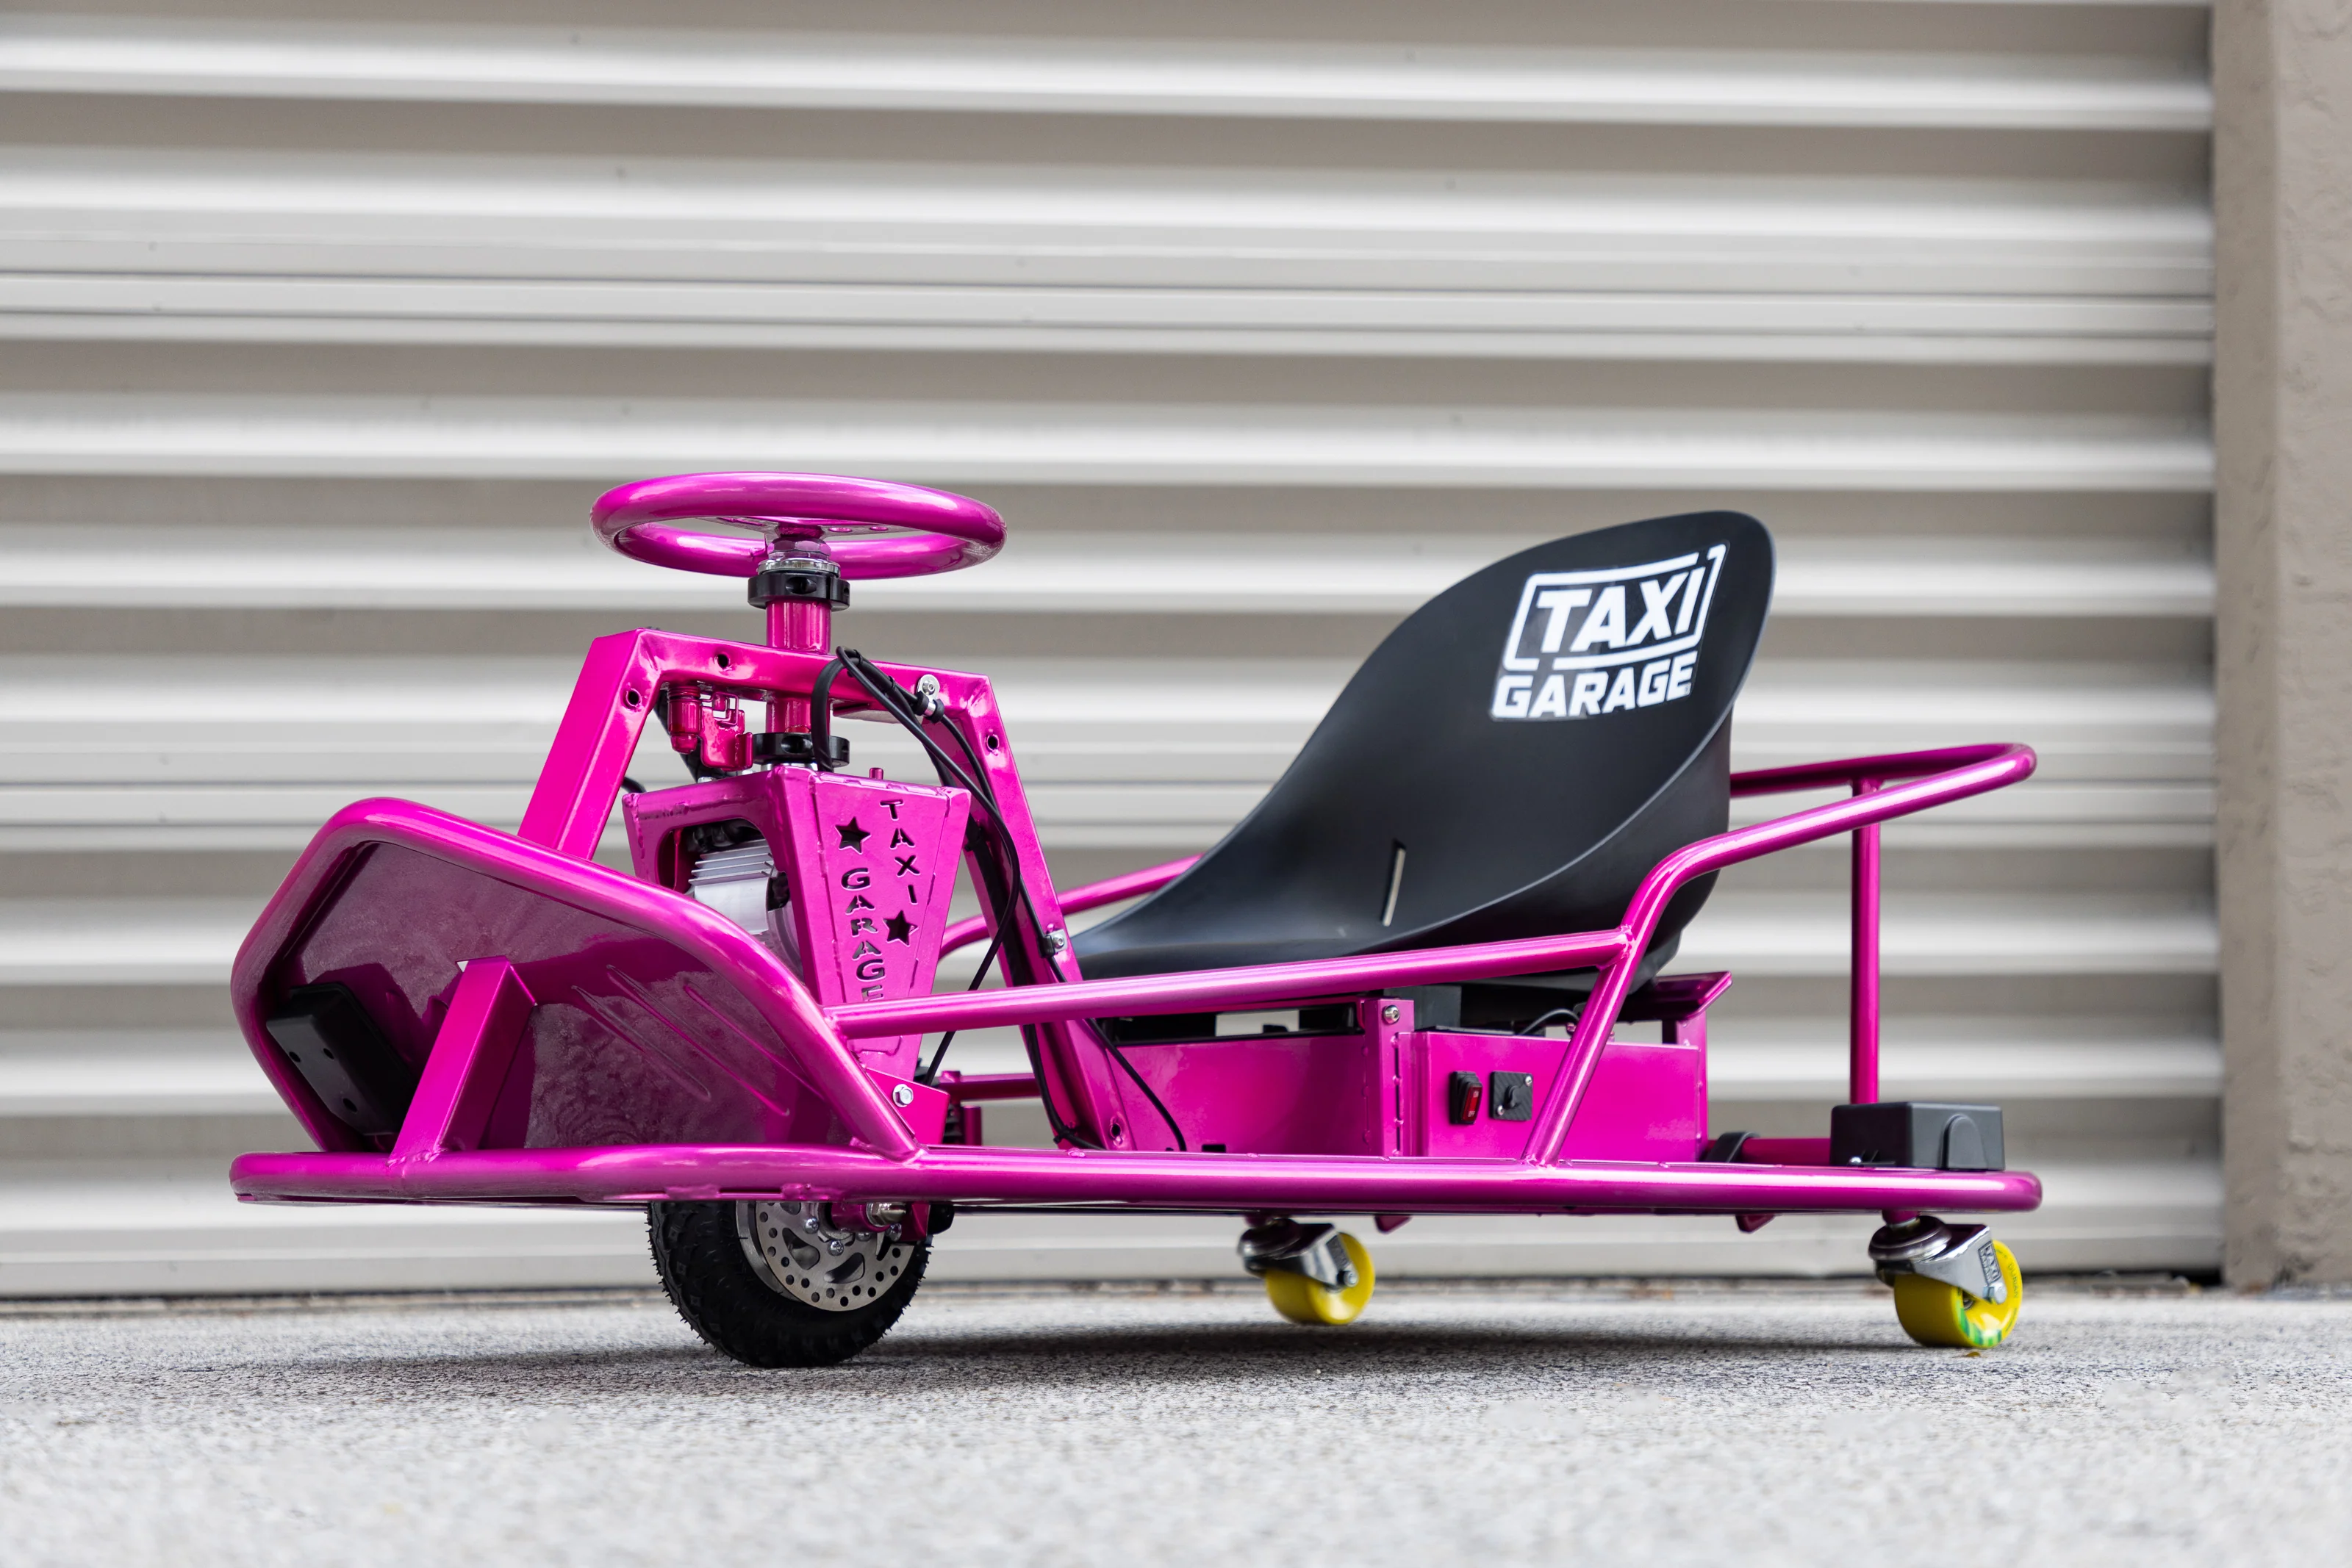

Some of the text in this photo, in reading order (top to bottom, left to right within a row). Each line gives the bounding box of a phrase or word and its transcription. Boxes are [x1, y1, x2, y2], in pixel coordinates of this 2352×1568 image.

[1536, 567, 1705, 653] TAXI
[1491, 650, 1698, 719] GARAGE
[880, 799, 920, 905] TAXI
[841, 867, 886, 1001] GARAGE
[1985, 1245, 2000, 1279] TAXI
